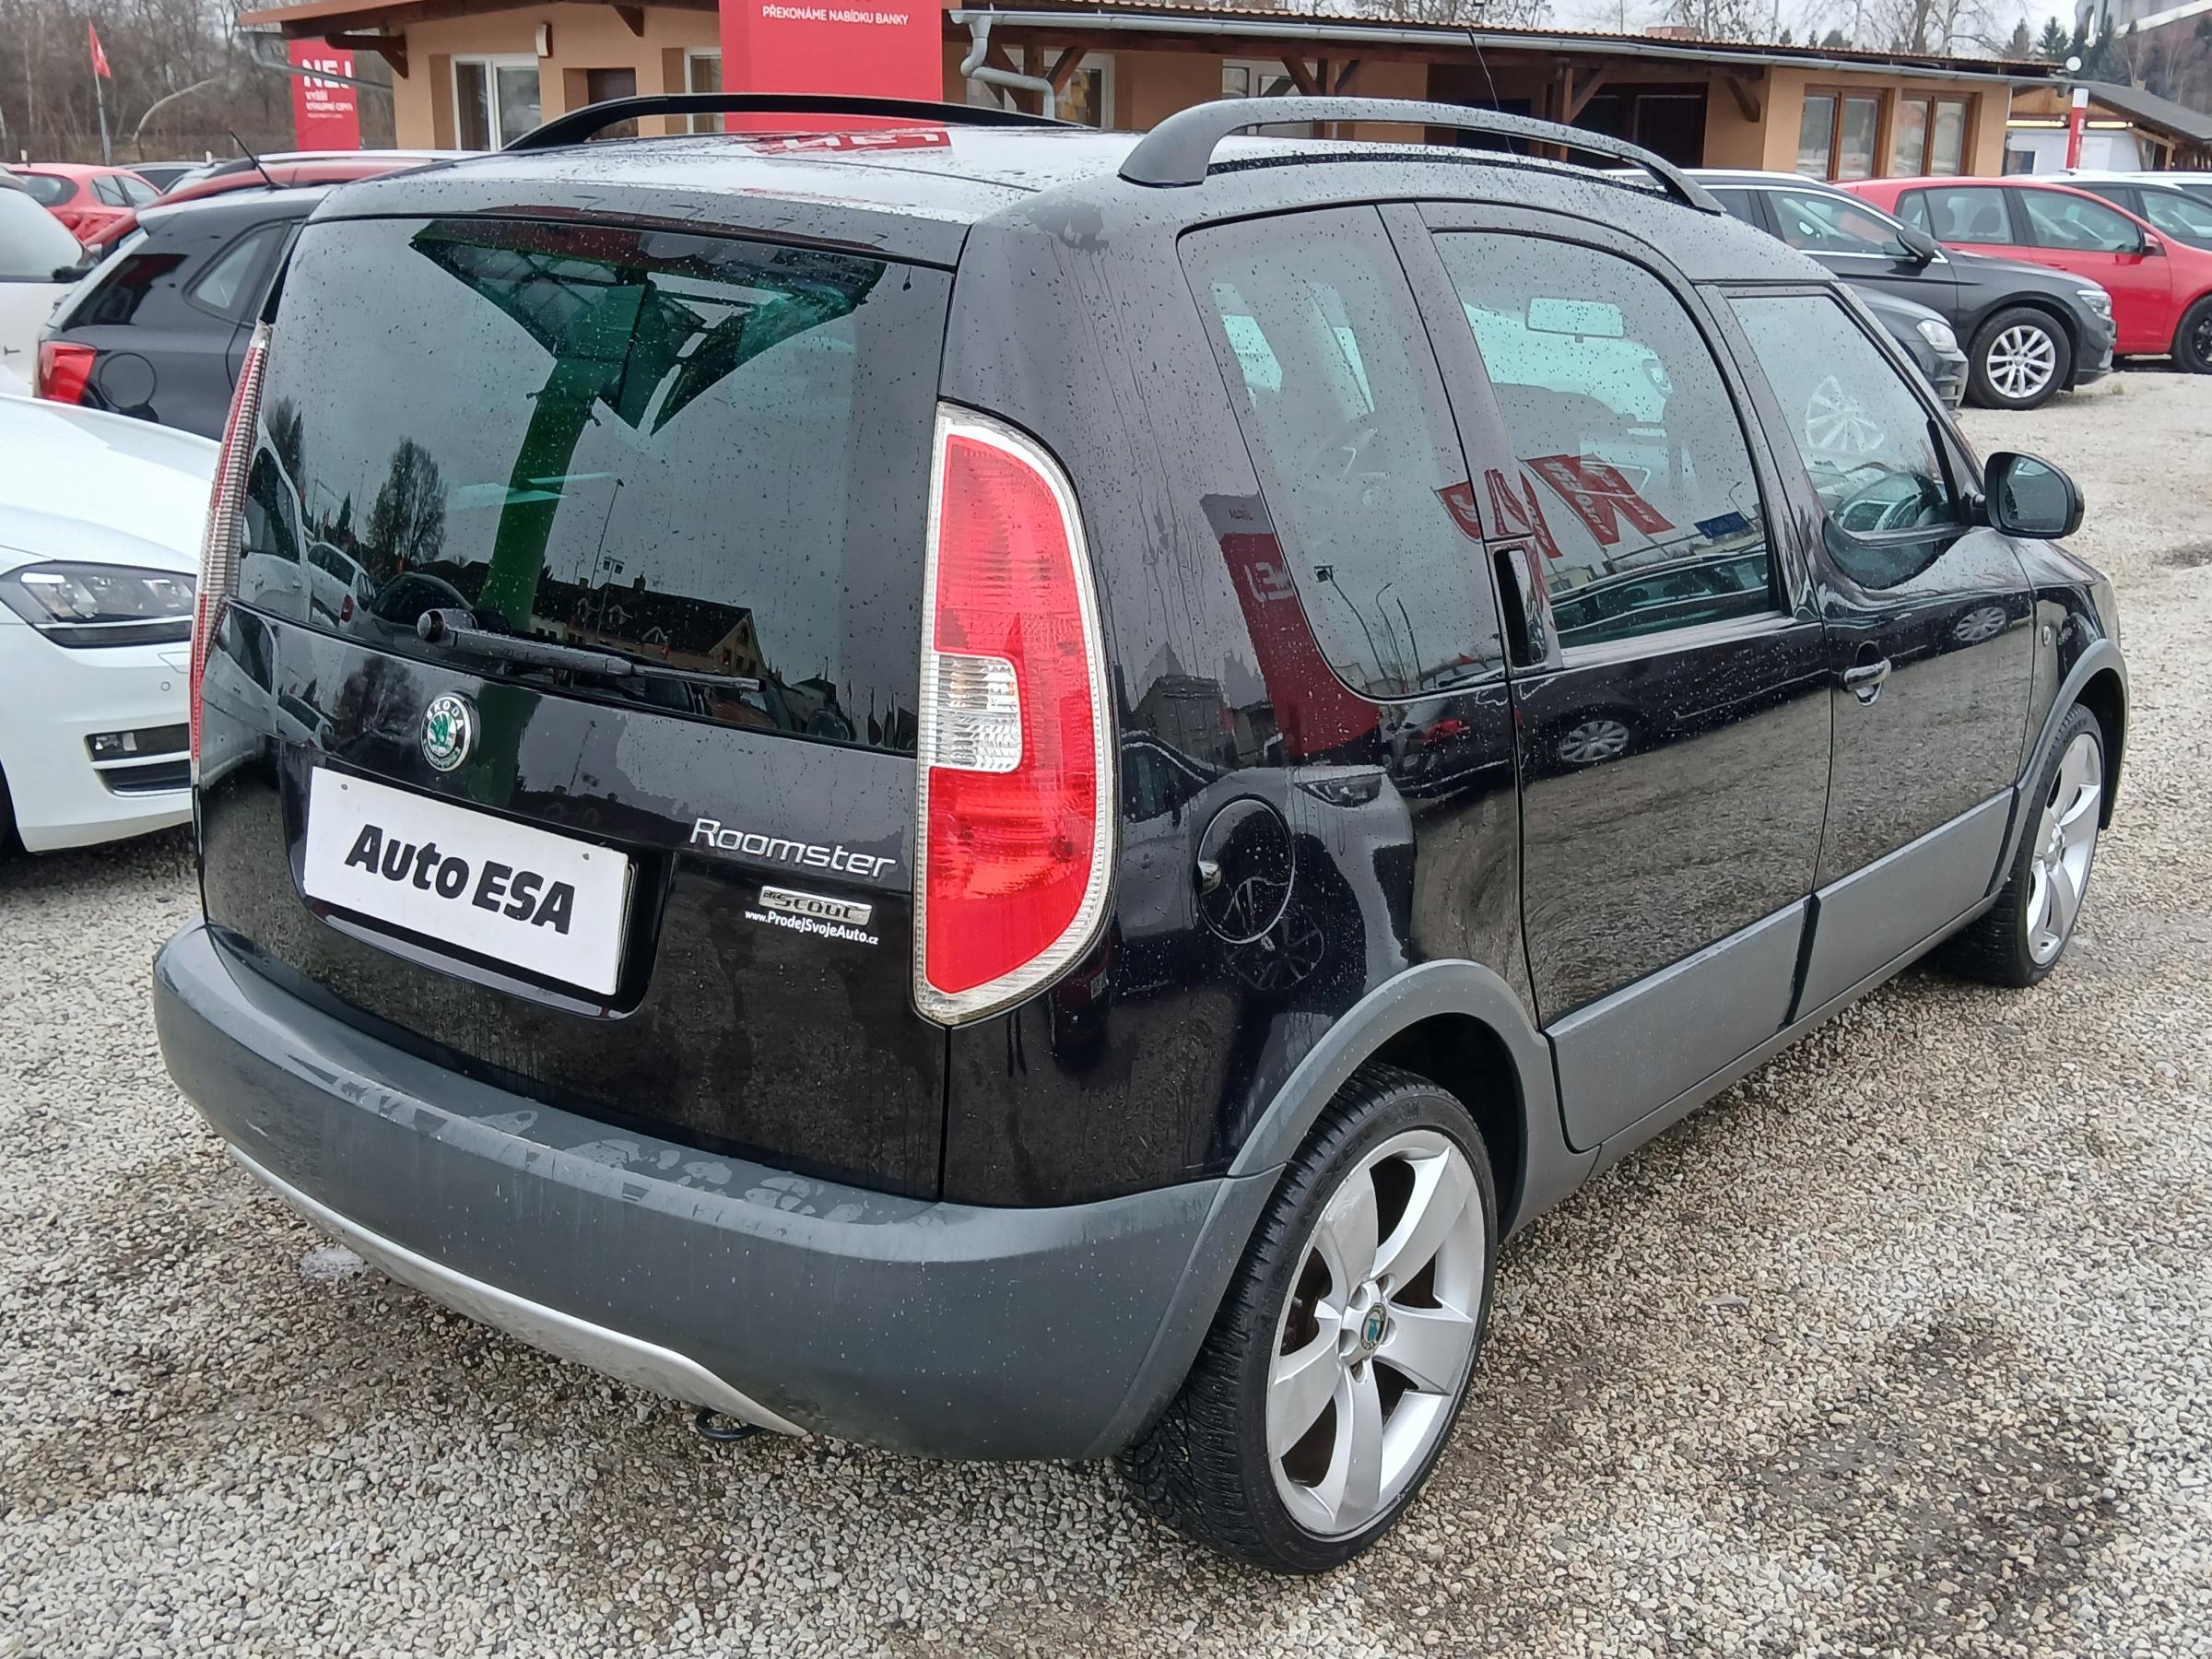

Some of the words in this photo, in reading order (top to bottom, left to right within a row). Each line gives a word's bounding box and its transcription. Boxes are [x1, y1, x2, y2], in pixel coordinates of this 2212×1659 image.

[762, 4, 828, 21] PŘEKONÁME
[829, 9, 875, 24] NABÍDKU
[876, 13, 909, 25] BANKY
[689, 818, 897, 877] Roomster
[345, 824, 470, 900] Auto
[472, 860, 576, 935] ESA
[744, 910, 879, 946] www.ProdejSvojeAuto.cz
